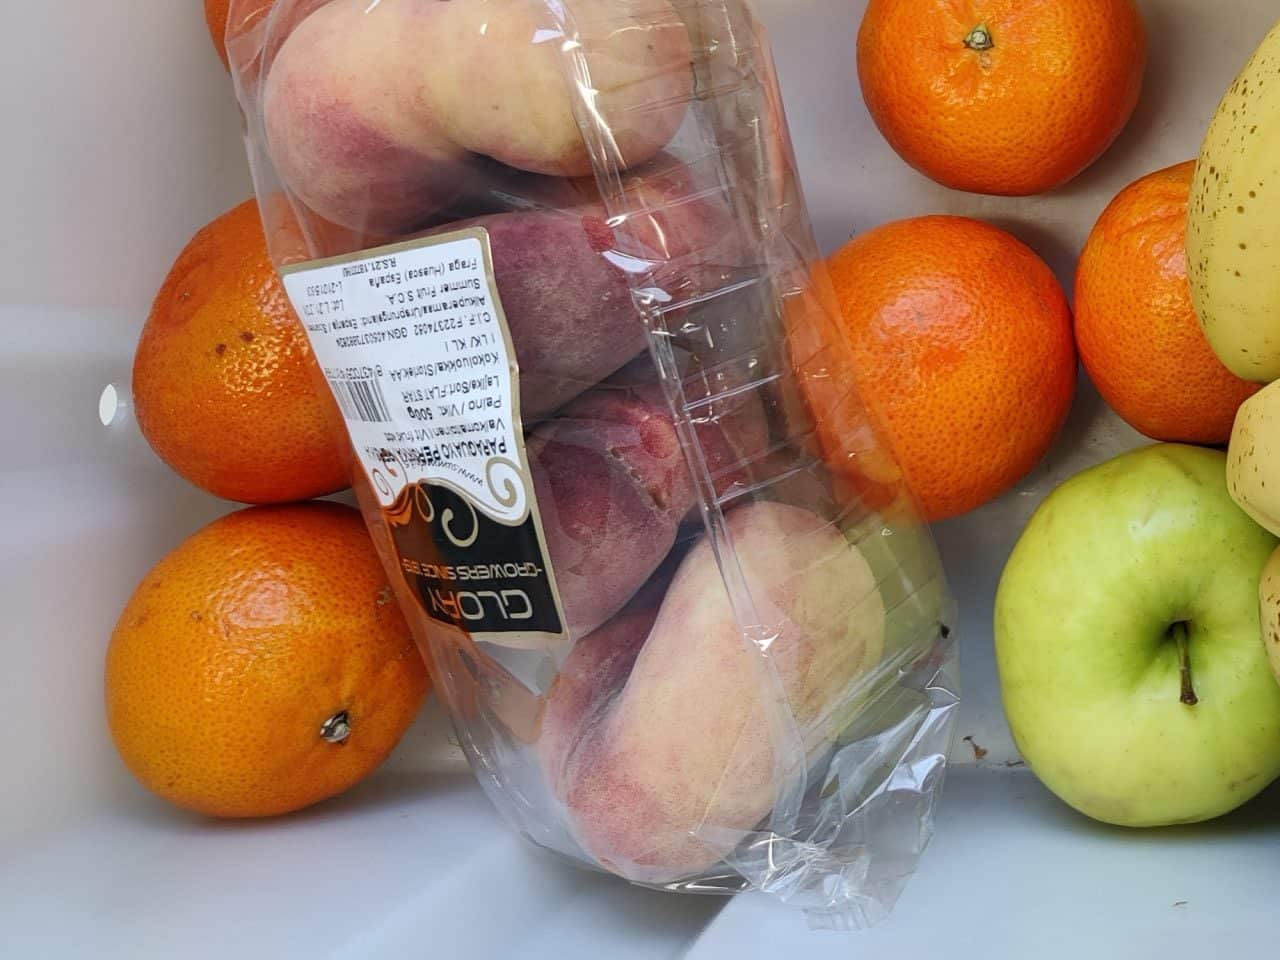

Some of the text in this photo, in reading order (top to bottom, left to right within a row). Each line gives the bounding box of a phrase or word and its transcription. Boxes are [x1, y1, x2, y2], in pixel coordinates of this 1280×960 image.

[368, 257, 477, 289] Fraga (Huesca) España
[440, 277, 480, 294] Summer
[401, 388, 424, 404] STAR
[468, 395, 502, 411] Paino
[407, 406, 433, 420] 500g
[441, 436, 507, 459] PARAGUAYO
[428, 587, 533, 620] GLORY
